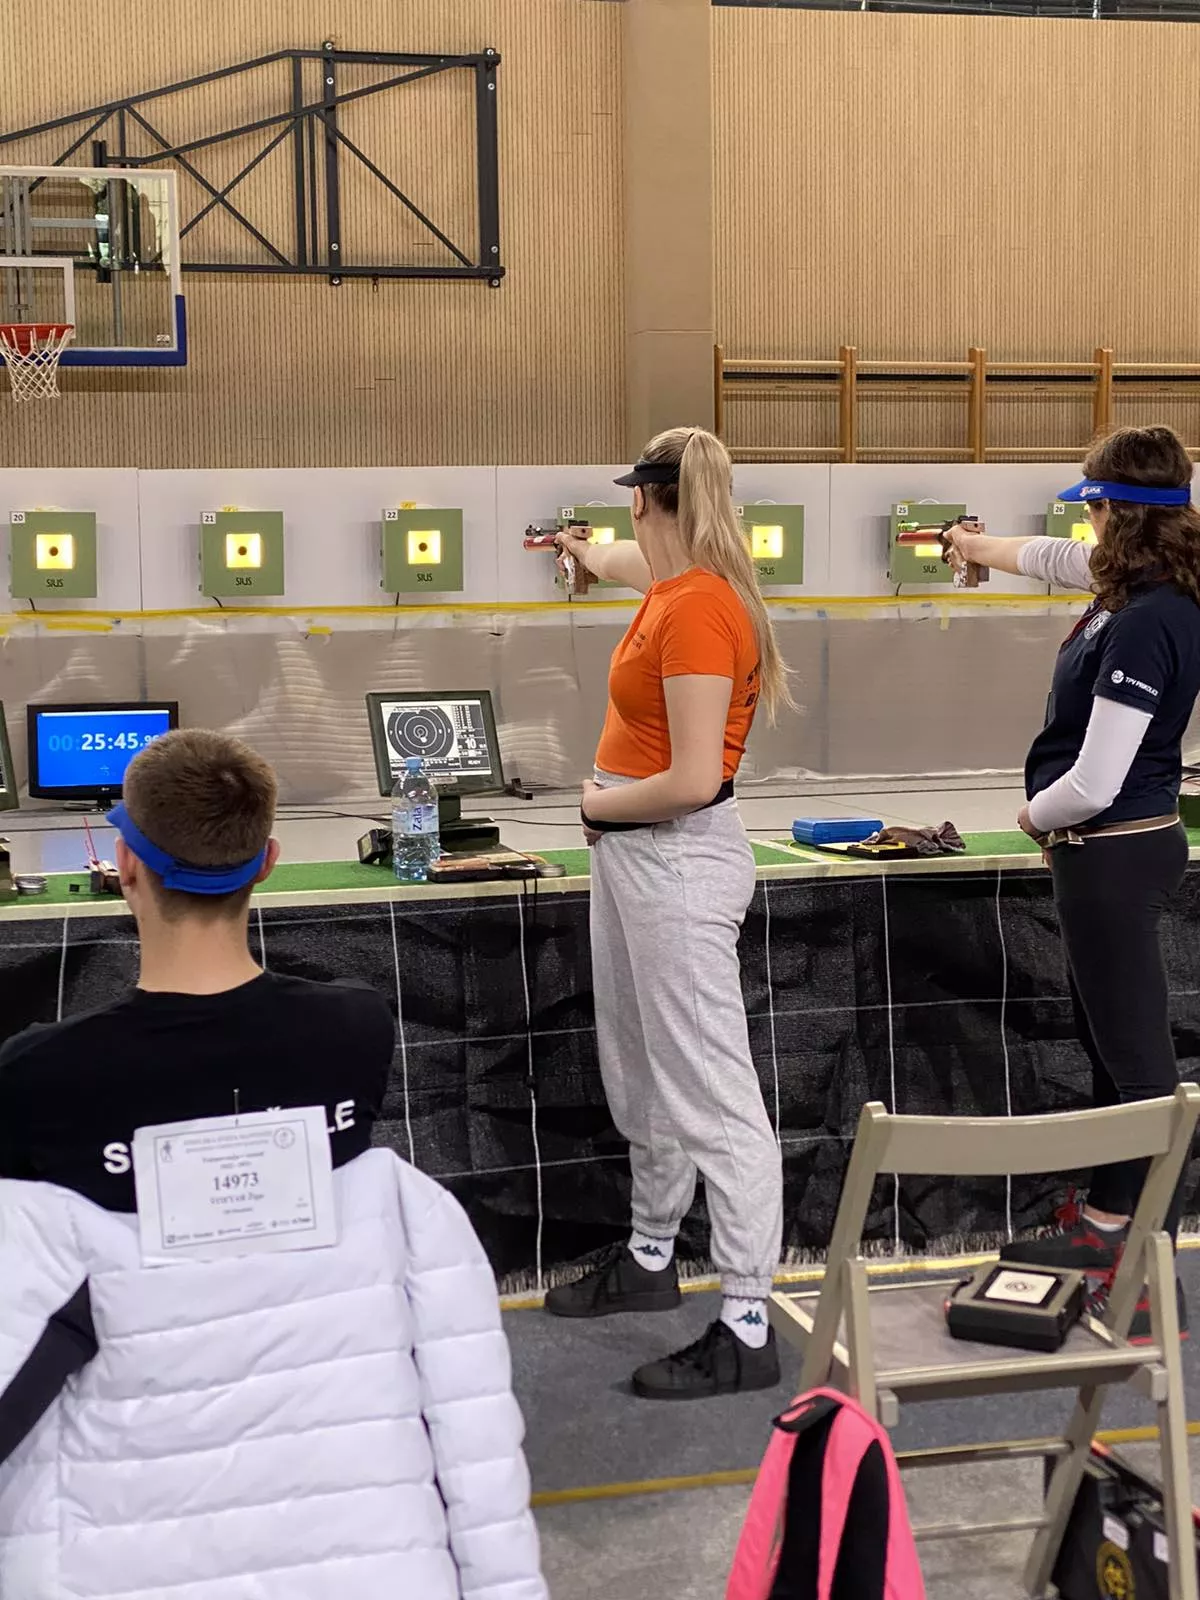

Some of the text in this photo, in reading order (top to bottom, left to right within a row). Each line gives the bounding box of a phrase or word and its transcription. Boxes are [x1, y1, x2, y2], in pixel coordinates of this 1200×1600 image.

[563, 509, 573, 517] 23
[898, 506, 907, 514] 25
[13, 514, 24, 522] 20
[387, 511, 397, 519] 22
[923, 565, 938, 574] SIUS
[235, 576, 253, 586] SIUS
[416, 573, 433, 582] SIUS
[46, 578, 64, 588] SIUS
[412, 806, 423, 831] Zala
[213, 1171, 259, 1191] 14973
